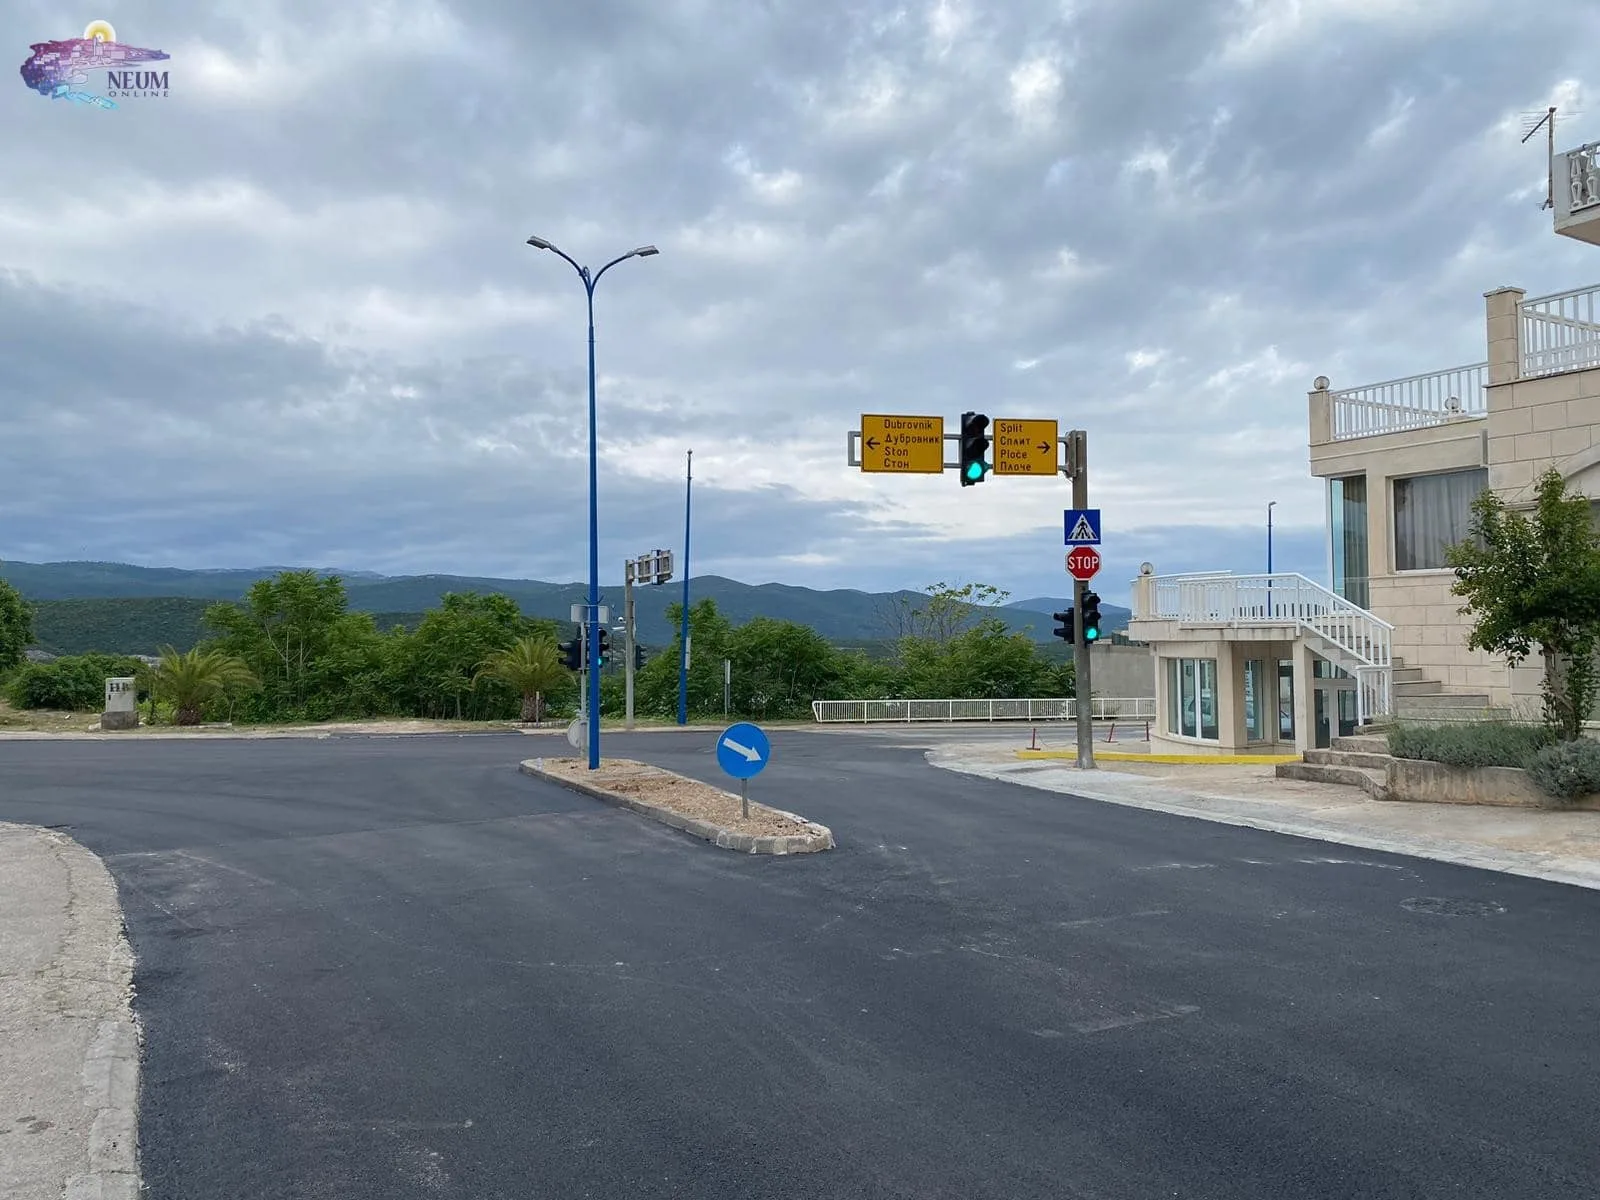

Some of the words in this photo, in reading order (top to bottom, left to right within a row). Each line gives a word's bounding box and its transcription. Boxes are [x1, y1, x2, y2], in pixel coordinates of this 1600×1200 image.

[884, 418, 933, 429] Dubrovnik
[1000, 422, 1023, 434] Split
[884, 432, 940, 444] Дубровник
[1000, 436, 1031, 446] Сплит
[884, 446, 909, 456] Ston
[884, 457, 909, 468] Стон
[1000, 461, 1031, 471] Плоче
[1067, 556, 1099, 570] STOP
